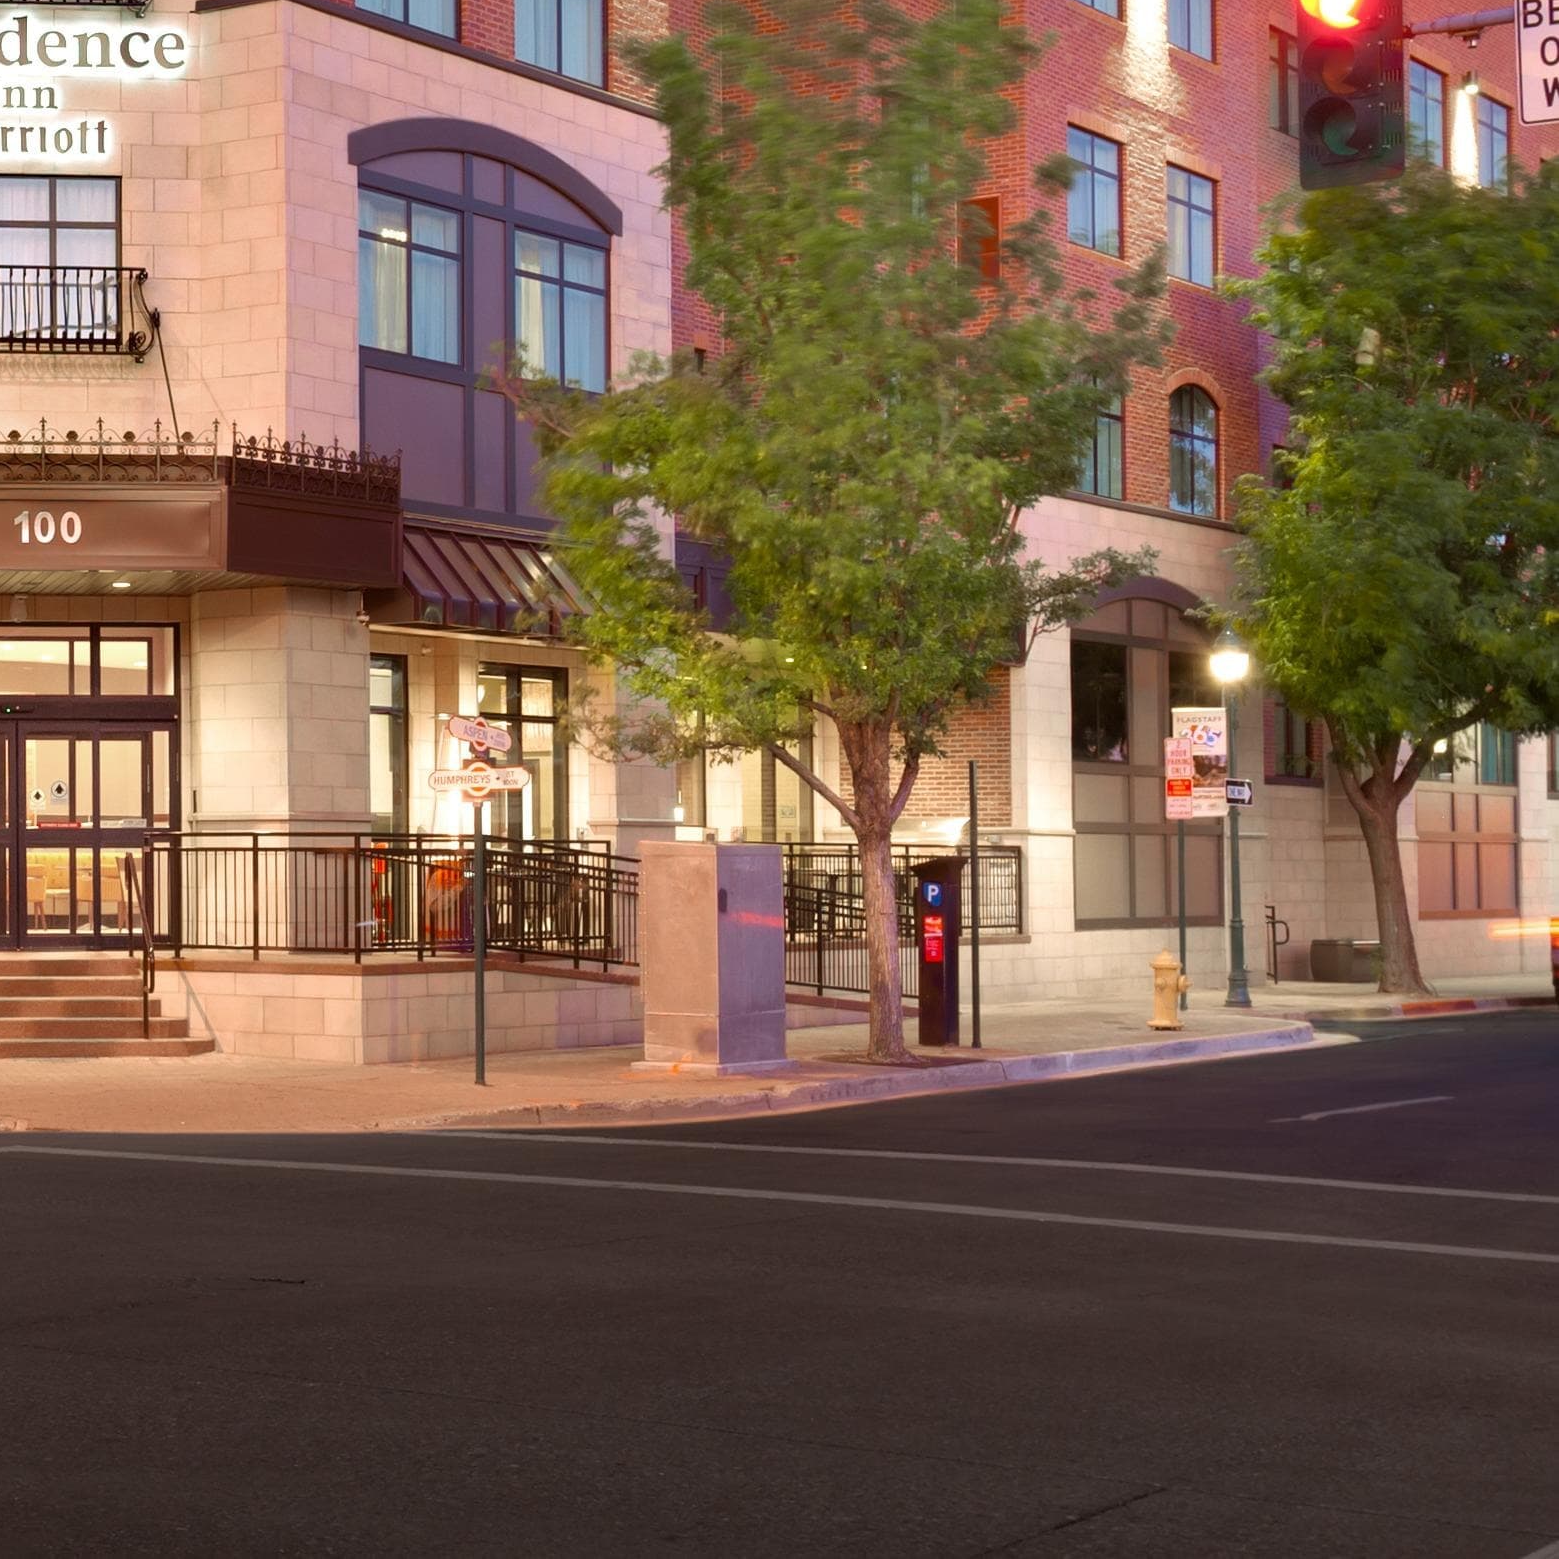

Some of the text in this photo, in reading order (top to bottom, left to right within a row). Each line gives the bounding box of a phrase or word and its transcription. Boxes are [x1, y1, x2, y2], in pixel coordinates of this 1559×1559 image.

[13, 510, 82, 544] 100
[463, 725, 488, 742] ASPEN
[434, 774, 490, 786] HUMPHREYS
[928, 884, 940, 902] P
